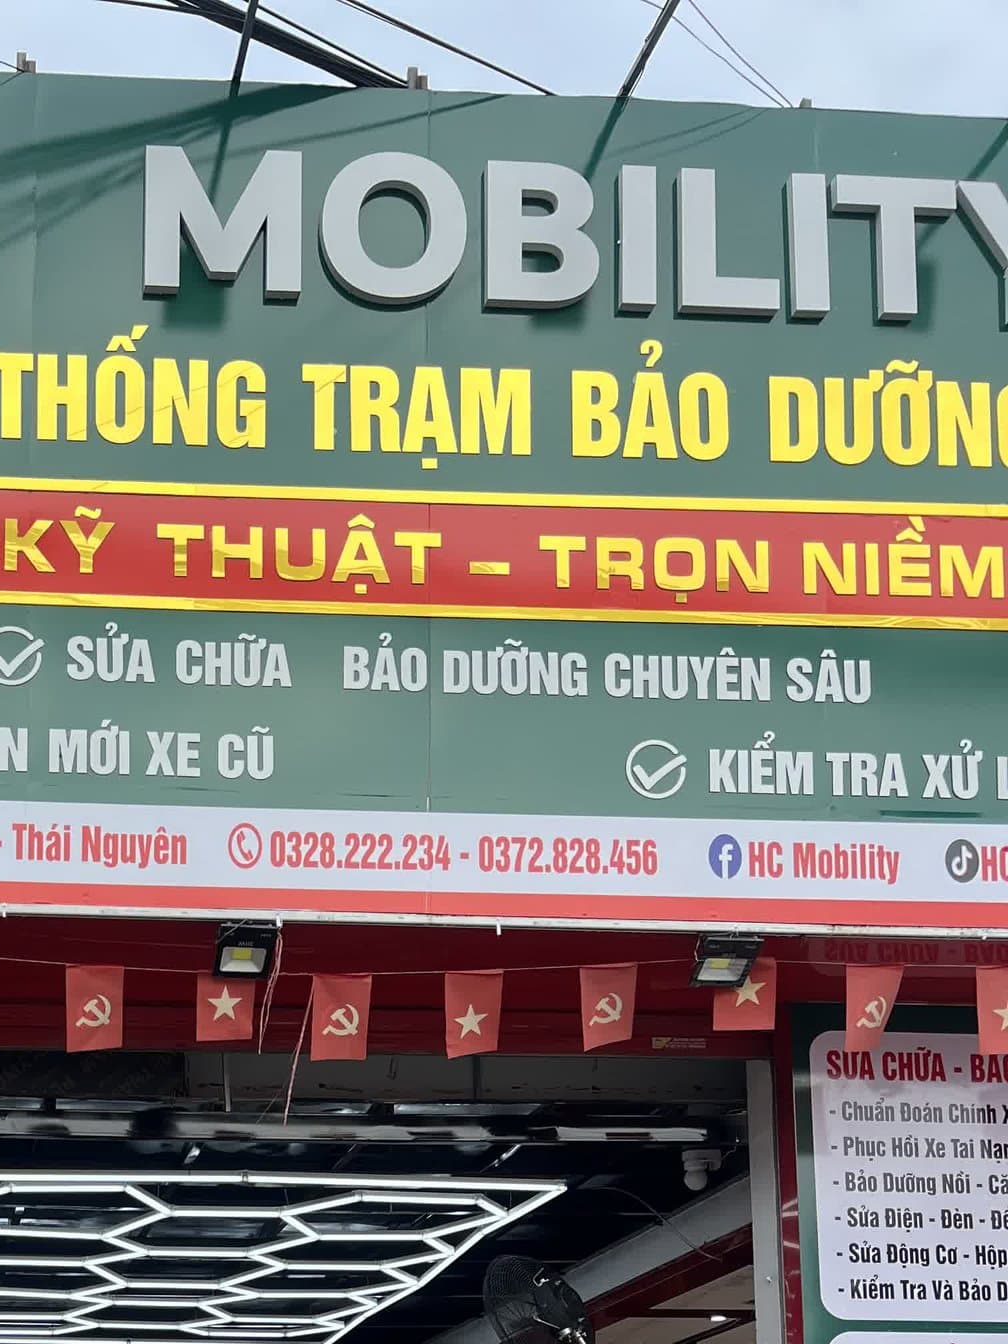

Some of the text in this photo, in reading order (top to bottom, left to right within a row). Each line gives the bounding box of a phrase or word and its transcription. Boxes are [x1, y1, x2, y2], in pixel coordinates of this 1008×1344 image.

[302, 363, 531, 470] TRẠM
[572, 340, 728, 460] BẢO
[769, 359, 1008, 467] DƯỠN
[4, 507, 114, 573] KỸ
[157, 514, 441, 595] THUẬT
[539, 535, 769, 604] TRỌN
[803, 516, 1003, 600] NIỀM
[66, 622, 872, 704] SỬA CHỮA BẢO DƯỠNG CHUYÊN SÂU
[48, 719, 131, 777] MỚI
[146, 732, 200, 778] XE
[218, 725, 275, 780] CŨ
[708, 731, 815, 796] KIỂM
[825, 752, 910, 798] TRA
[922, 739, 983, 800] XỬ
[12, 822, 71, 864] Thái
[81, 825, 188, 869] Nguyên
[269, 830, 452, 872] 0328.222.234
[478, 836, 659, 877] 0372.828.456
[748, 841, 900, 885] HC Mobility
[882, 1045, 947, 1082] CHỮA
[841, 1098, 895, 1123] Chuẩn
[900, 1101, 943, 1124] Đoán
[948, 1103, 997, 1125] Chính
[843, 1137, 886, 1161] Phục
[891, 1134, 920, 1158] Hồi
[925, 1138, 946, 1158] Xe
[951, 1138, 974, 1159] Tai
[845, 1170, 878, 1193] Bảo
[883, 1174, 937, 1196] Dưỡng
[942, 1170, 971, 1194] Nồi
[847, 1205, 880, 1229] Sửa
[885, 1208, 924, 1233] Điện
[941, 1207, 974, 1230] Đèn
[849, 1240, 1008, 1270] Sửa Động Cơ Hộp
[850, 1275, 895, 1300] Kiểm
[900, 1280, 927, 1301] Tra
[932, 1279, 954, 1301] Và
[959, 1277, 991, 1301] Bảo
